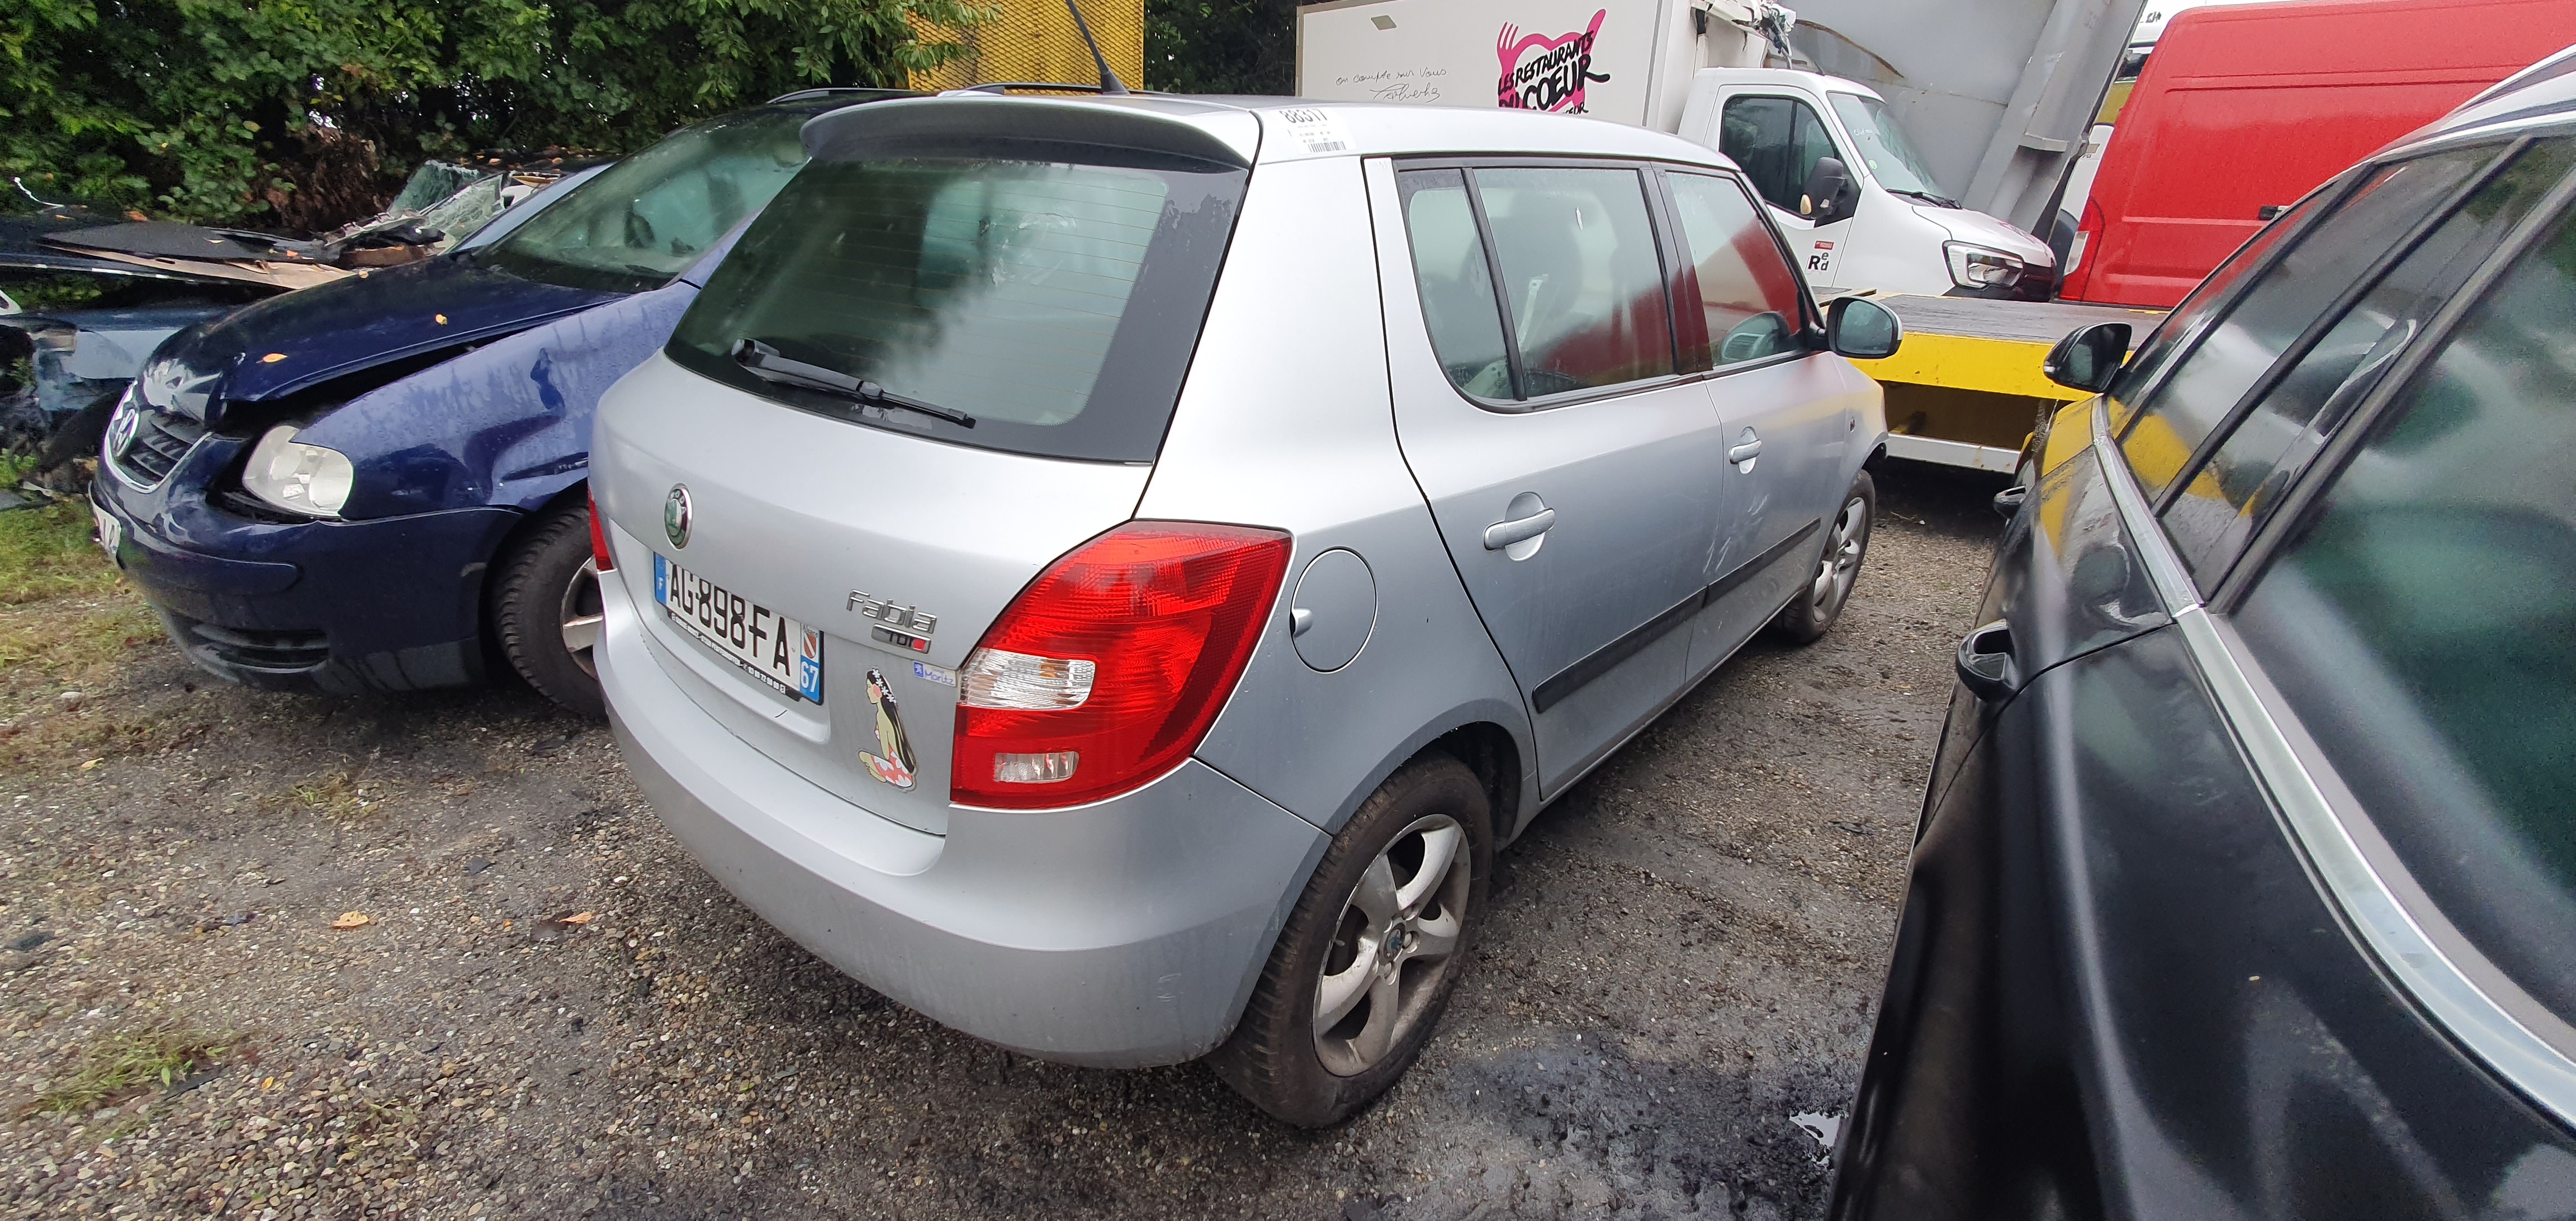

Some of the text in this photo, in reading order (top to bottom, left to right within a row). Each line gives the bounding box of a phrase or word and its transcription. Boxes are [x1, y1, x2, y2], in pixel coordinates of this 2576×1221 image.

[1515, 30, 1594, 88] RESTAURANTS
[1498, 72, 1514, 96] LES
[1522, 54, 1611, 111] COEUR
[1279, 108, 1328, 124] 88317
[846, 589, 937, 635] Fabia
[801, 661, 819, 693] 67
